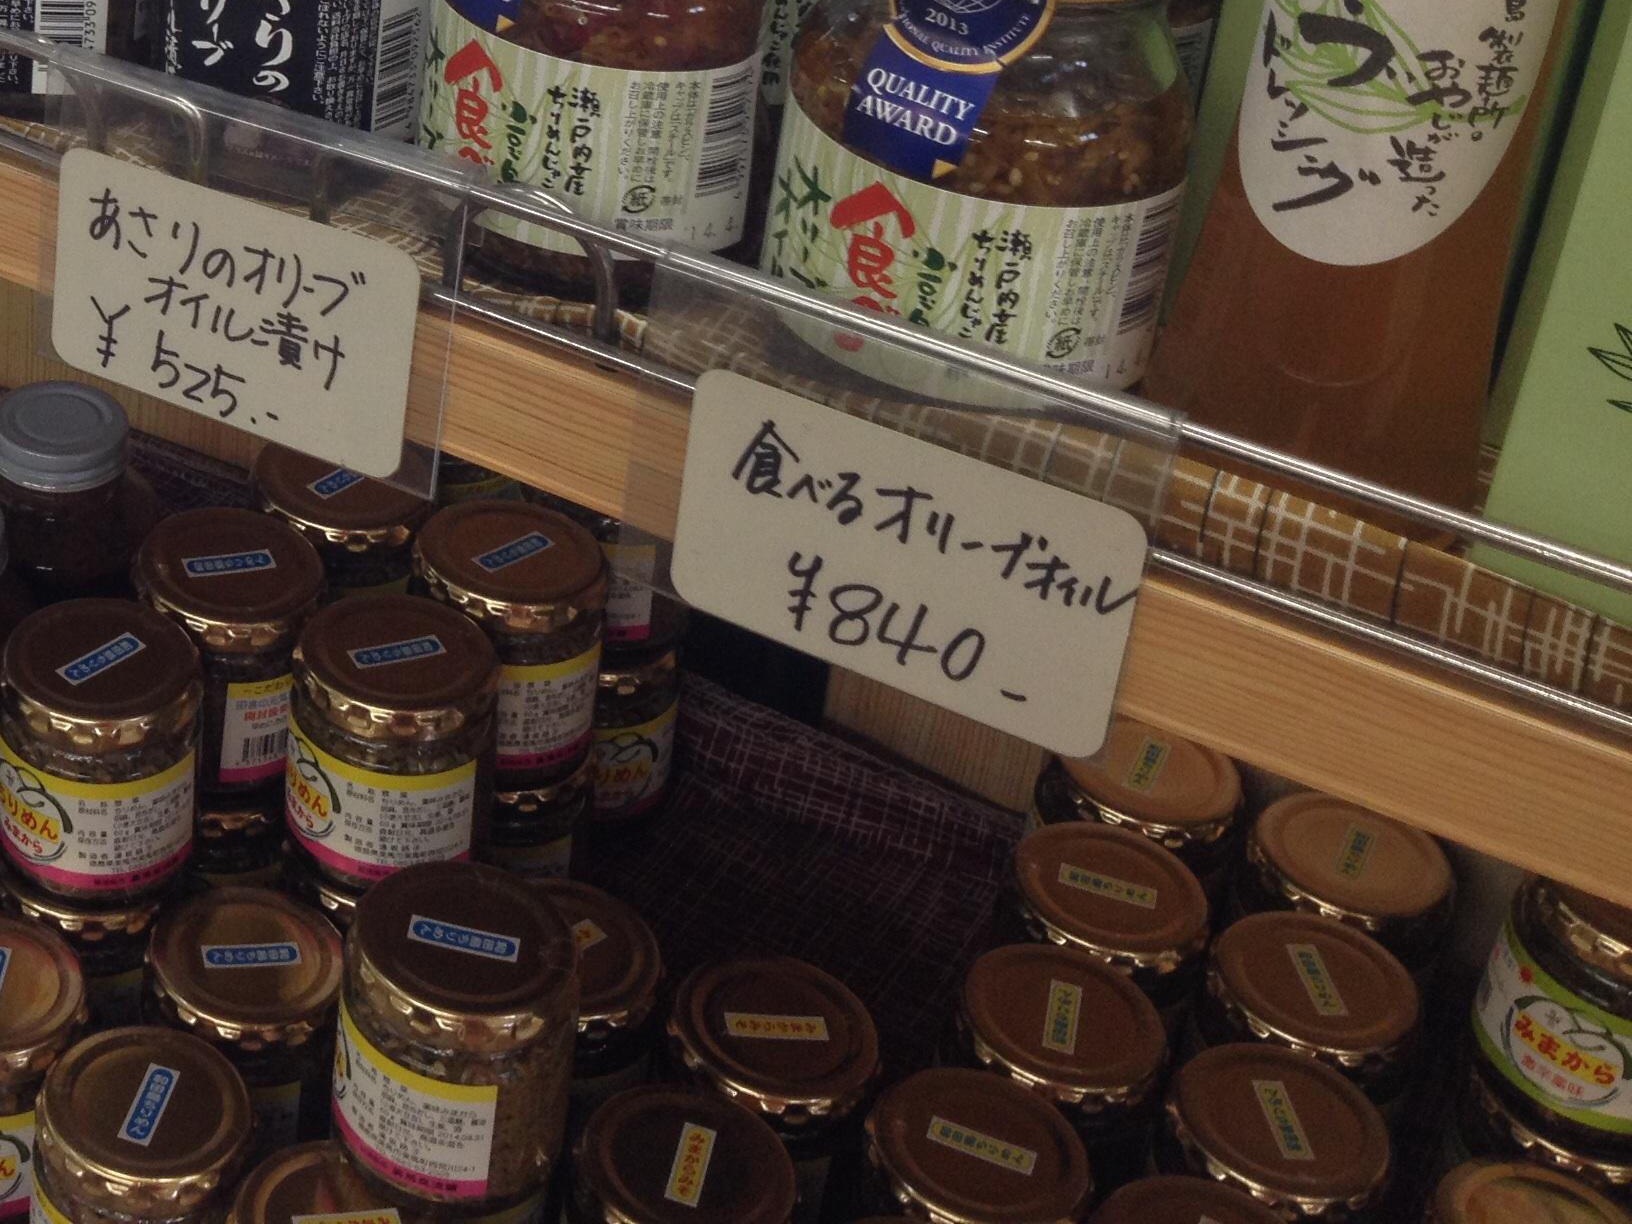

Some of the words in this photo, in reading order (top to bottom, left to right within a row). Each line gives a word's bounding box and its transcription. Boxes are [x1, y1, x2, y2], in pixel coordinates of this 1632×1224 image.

[924, 7, 970, 36] 2013
[855, 95, 959, 147] AWARD
[867, 67, 975, 121] QUALITY
[88, 188, 366, 317] あさりのオリーブ
[143, 275, 346, 392] オイル漬け
[1514, 1014, 1616, 1086] みまから
